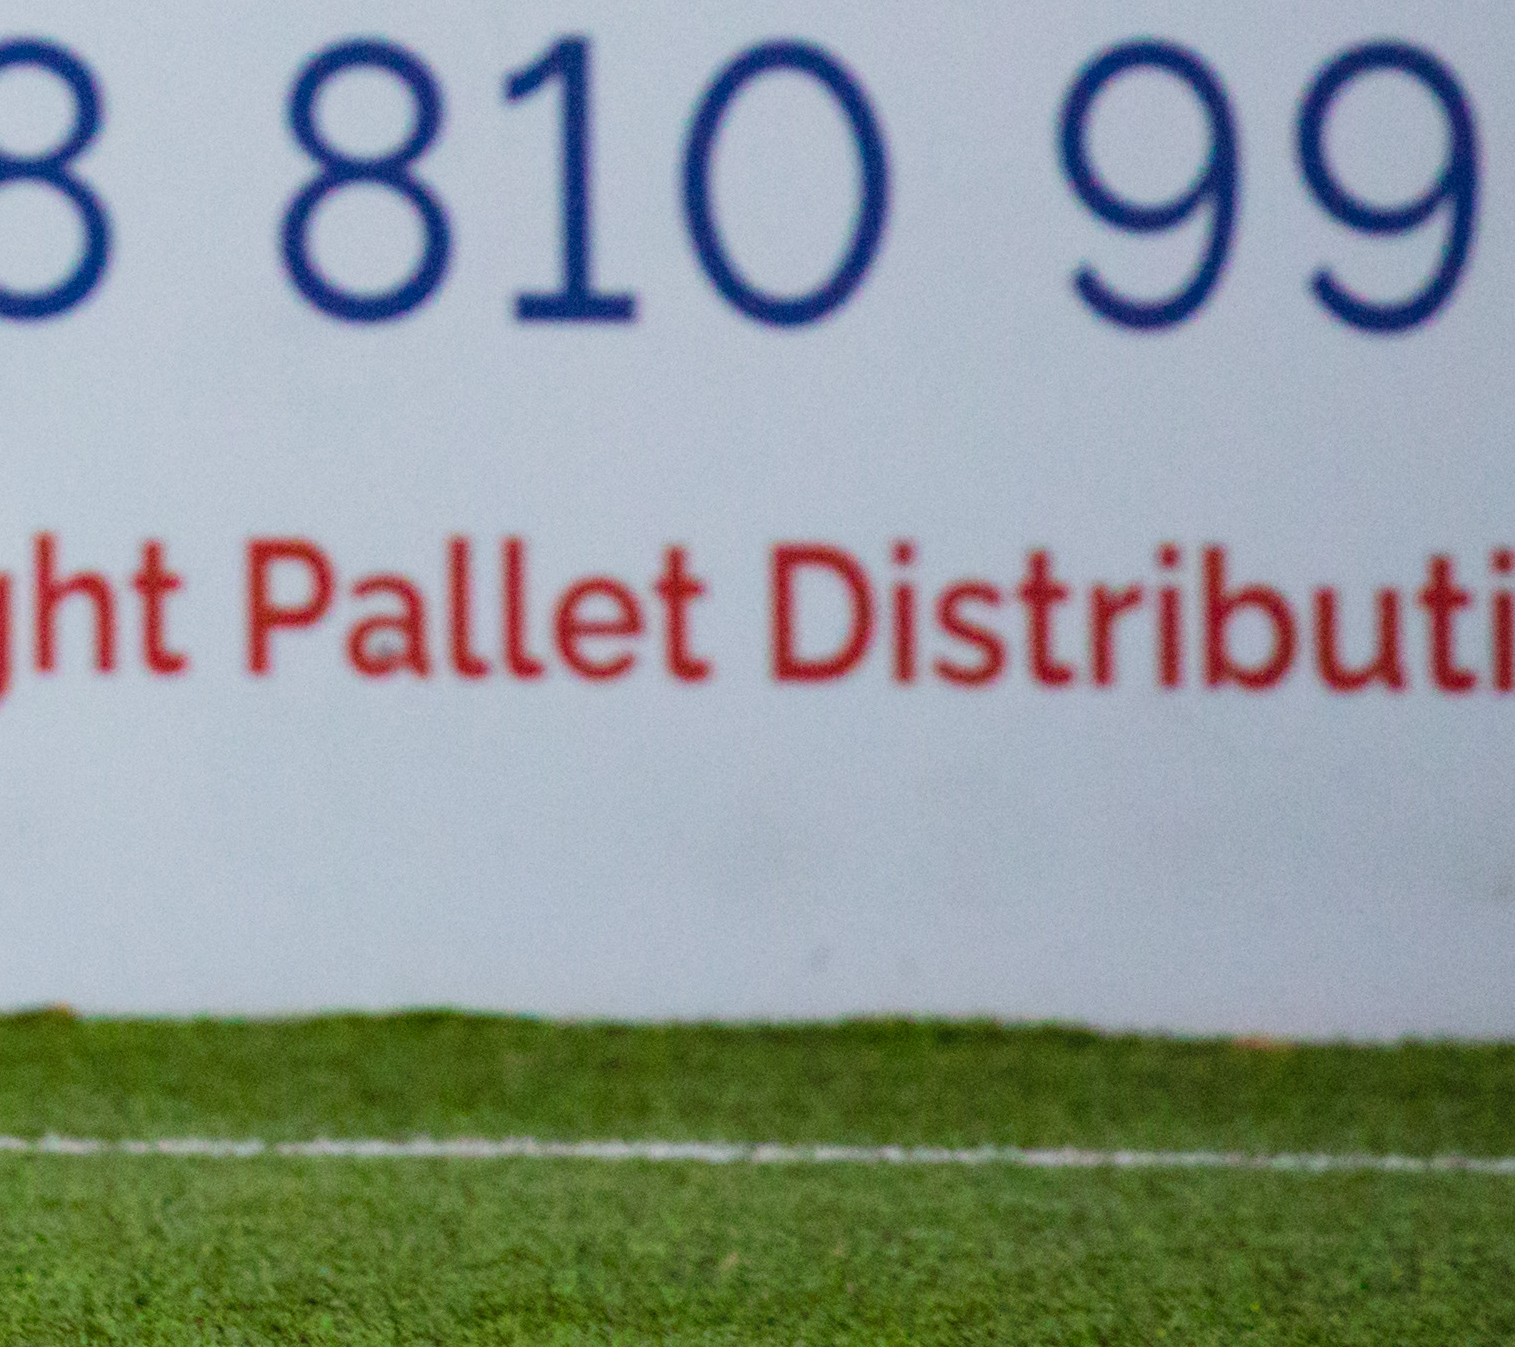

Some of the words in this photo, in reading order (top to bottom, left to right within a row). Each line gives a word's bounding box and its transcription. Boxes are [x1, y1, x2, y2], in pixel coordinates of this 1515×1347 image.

[274, 30, 894, 332] 810
[1052, 34, 1484, 337] 99
[245, 537, 709, 685] Pallet
[770, 536, 1515, 694] Distributi
